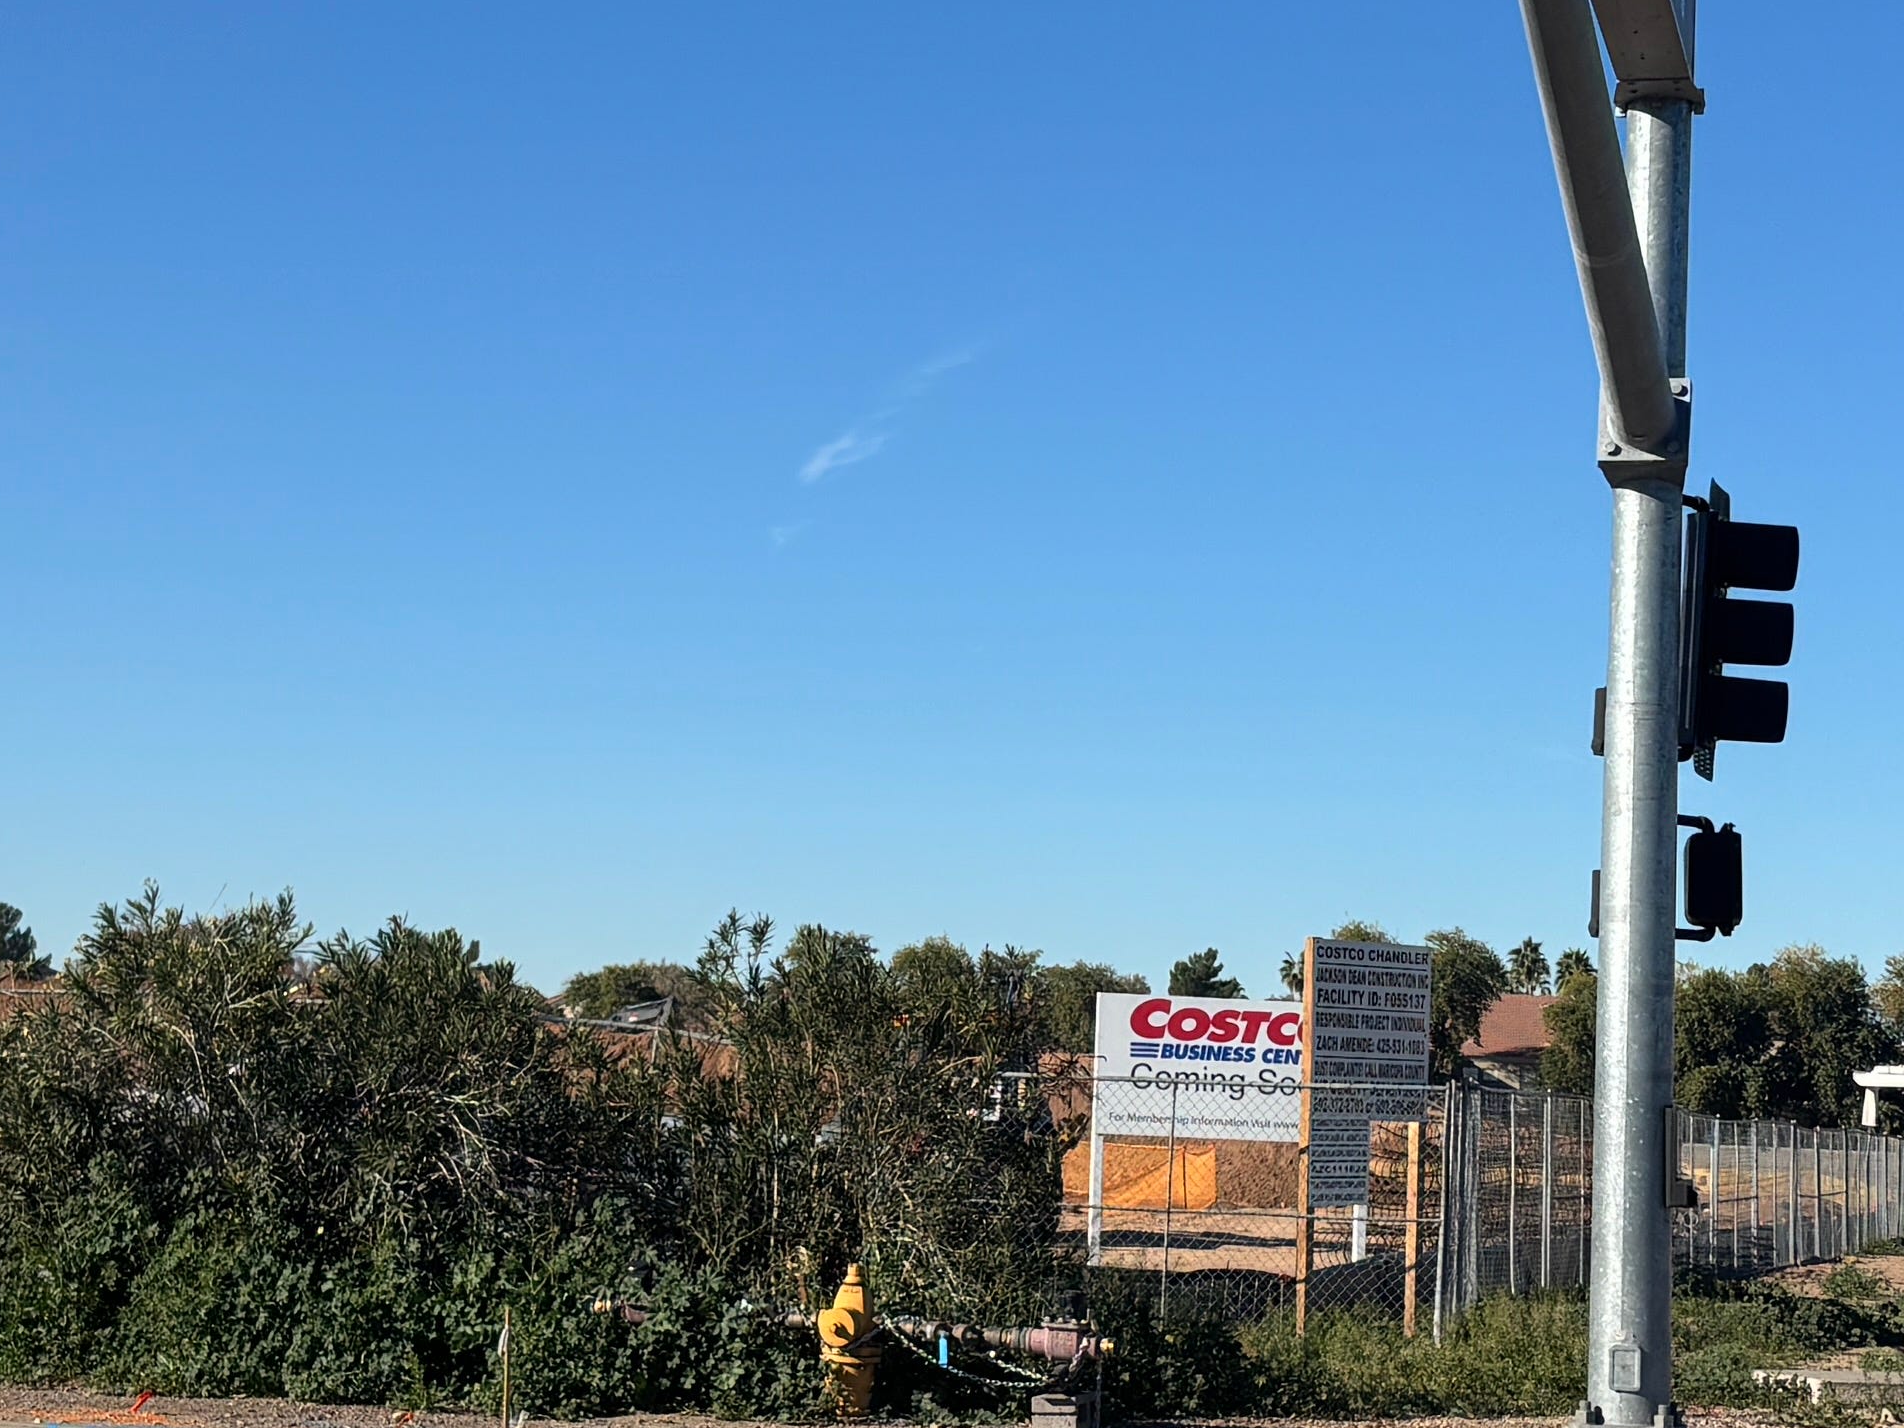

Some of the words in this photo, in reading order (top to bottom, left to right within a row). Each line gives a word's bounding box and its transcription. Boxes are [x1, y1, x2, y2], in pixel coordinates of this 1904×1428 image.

[1317, 945, 1364, 961] COSTCO
[1368, 950, 1429, 965] CHANDLER
[1349, 968, 1366, 985] DEAN
[1317, 988, 1365, 1005] FACILITY
[1367, 993, 1381, 1007] ID:
[1130, 998, 1303, 1046] COSTC
[1160, 1043, 1256, 1062] BUSINESS
[1261, 1047, 1303, 1065] CEN
[1131, 1062, 1245, 1100] Coming
[1258, 1068, 1302, 1096] So
[1109, 1112, 1124, 1122] For
[1127, 1112, 1189, 1126] Memberhip
[1191, 1115, 1248, 1127] Information
